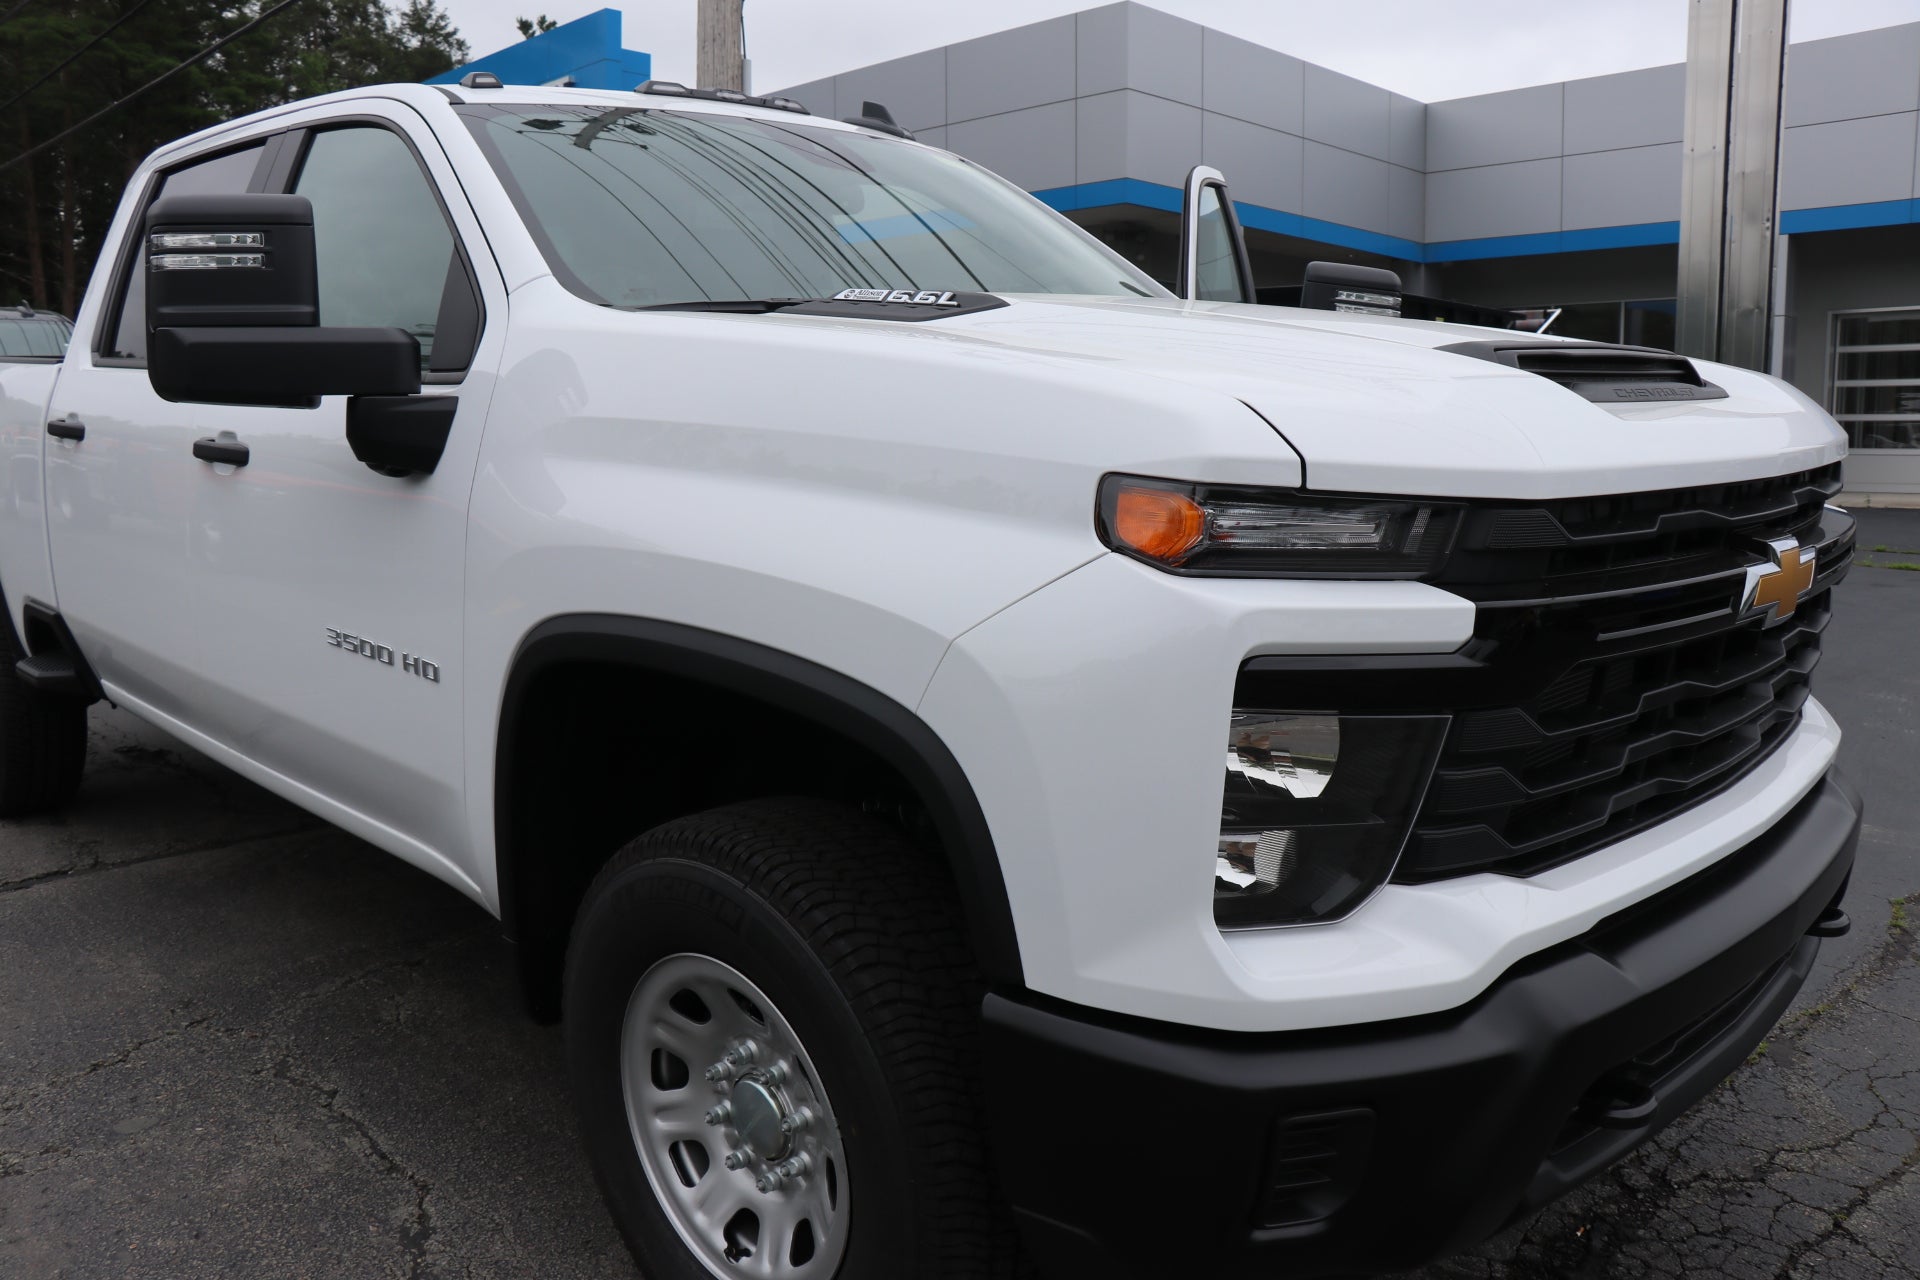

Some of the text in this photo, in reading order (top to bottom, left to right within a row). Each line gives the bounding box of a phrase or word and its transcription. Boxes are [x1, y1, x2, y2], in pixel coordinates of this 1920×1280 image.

[1612, 388, 1696, 399] CHEVROLET
[326, 626, 440, 683] 3500 HD
